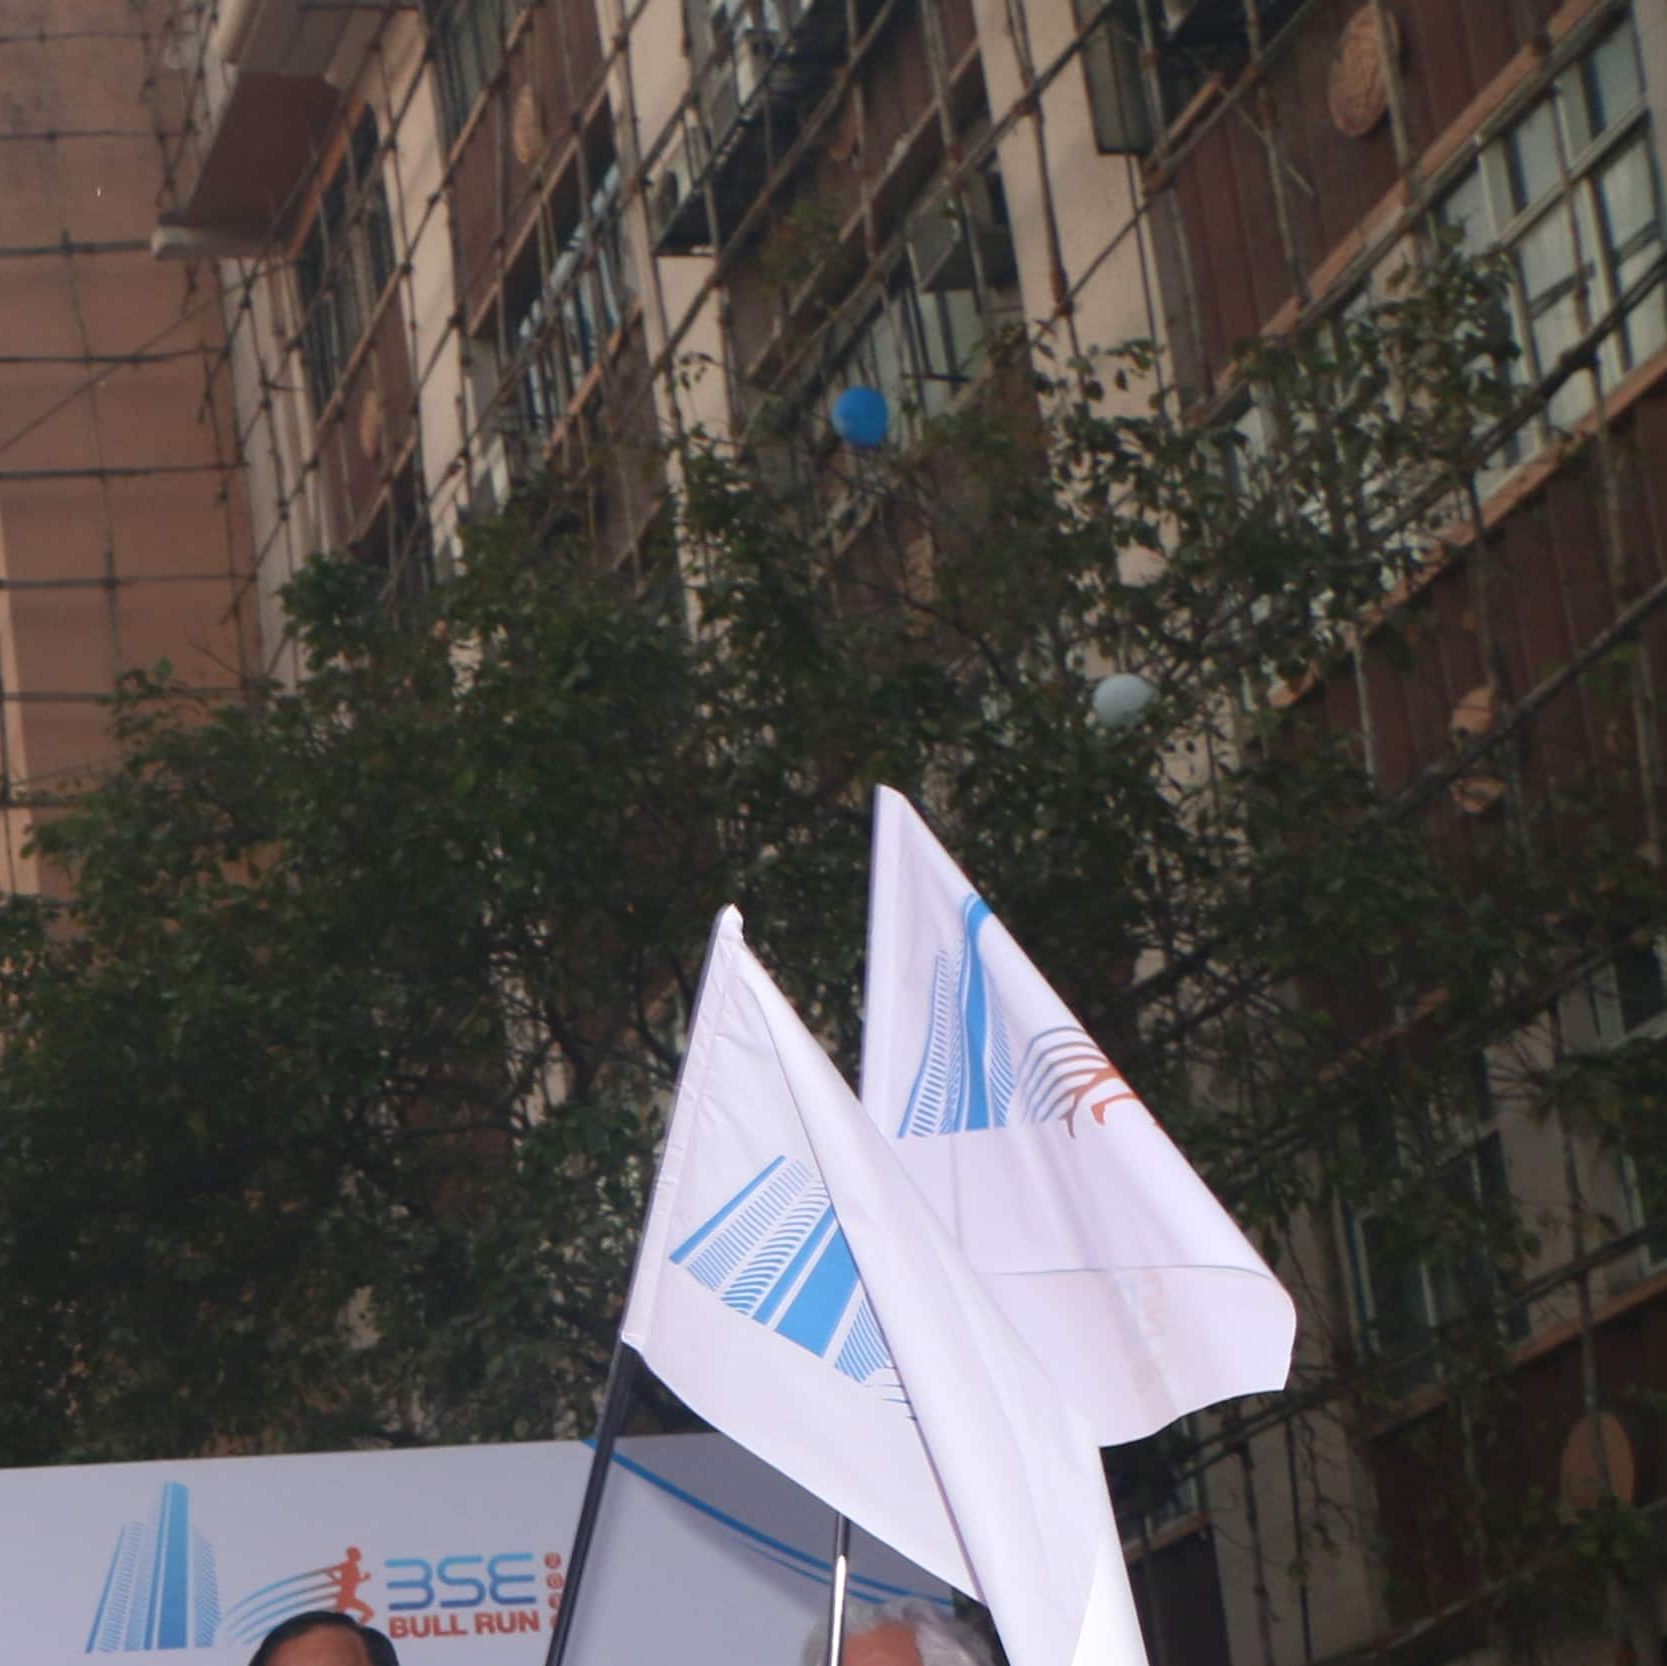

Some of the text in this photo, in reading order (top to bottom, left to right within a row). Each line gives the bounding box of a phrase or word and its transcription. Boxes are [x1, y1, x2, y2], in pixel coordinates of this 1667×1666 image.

[384, 1552, 538, 1611] BSE
[388, 1611, 540, 1640] BULL RUN
